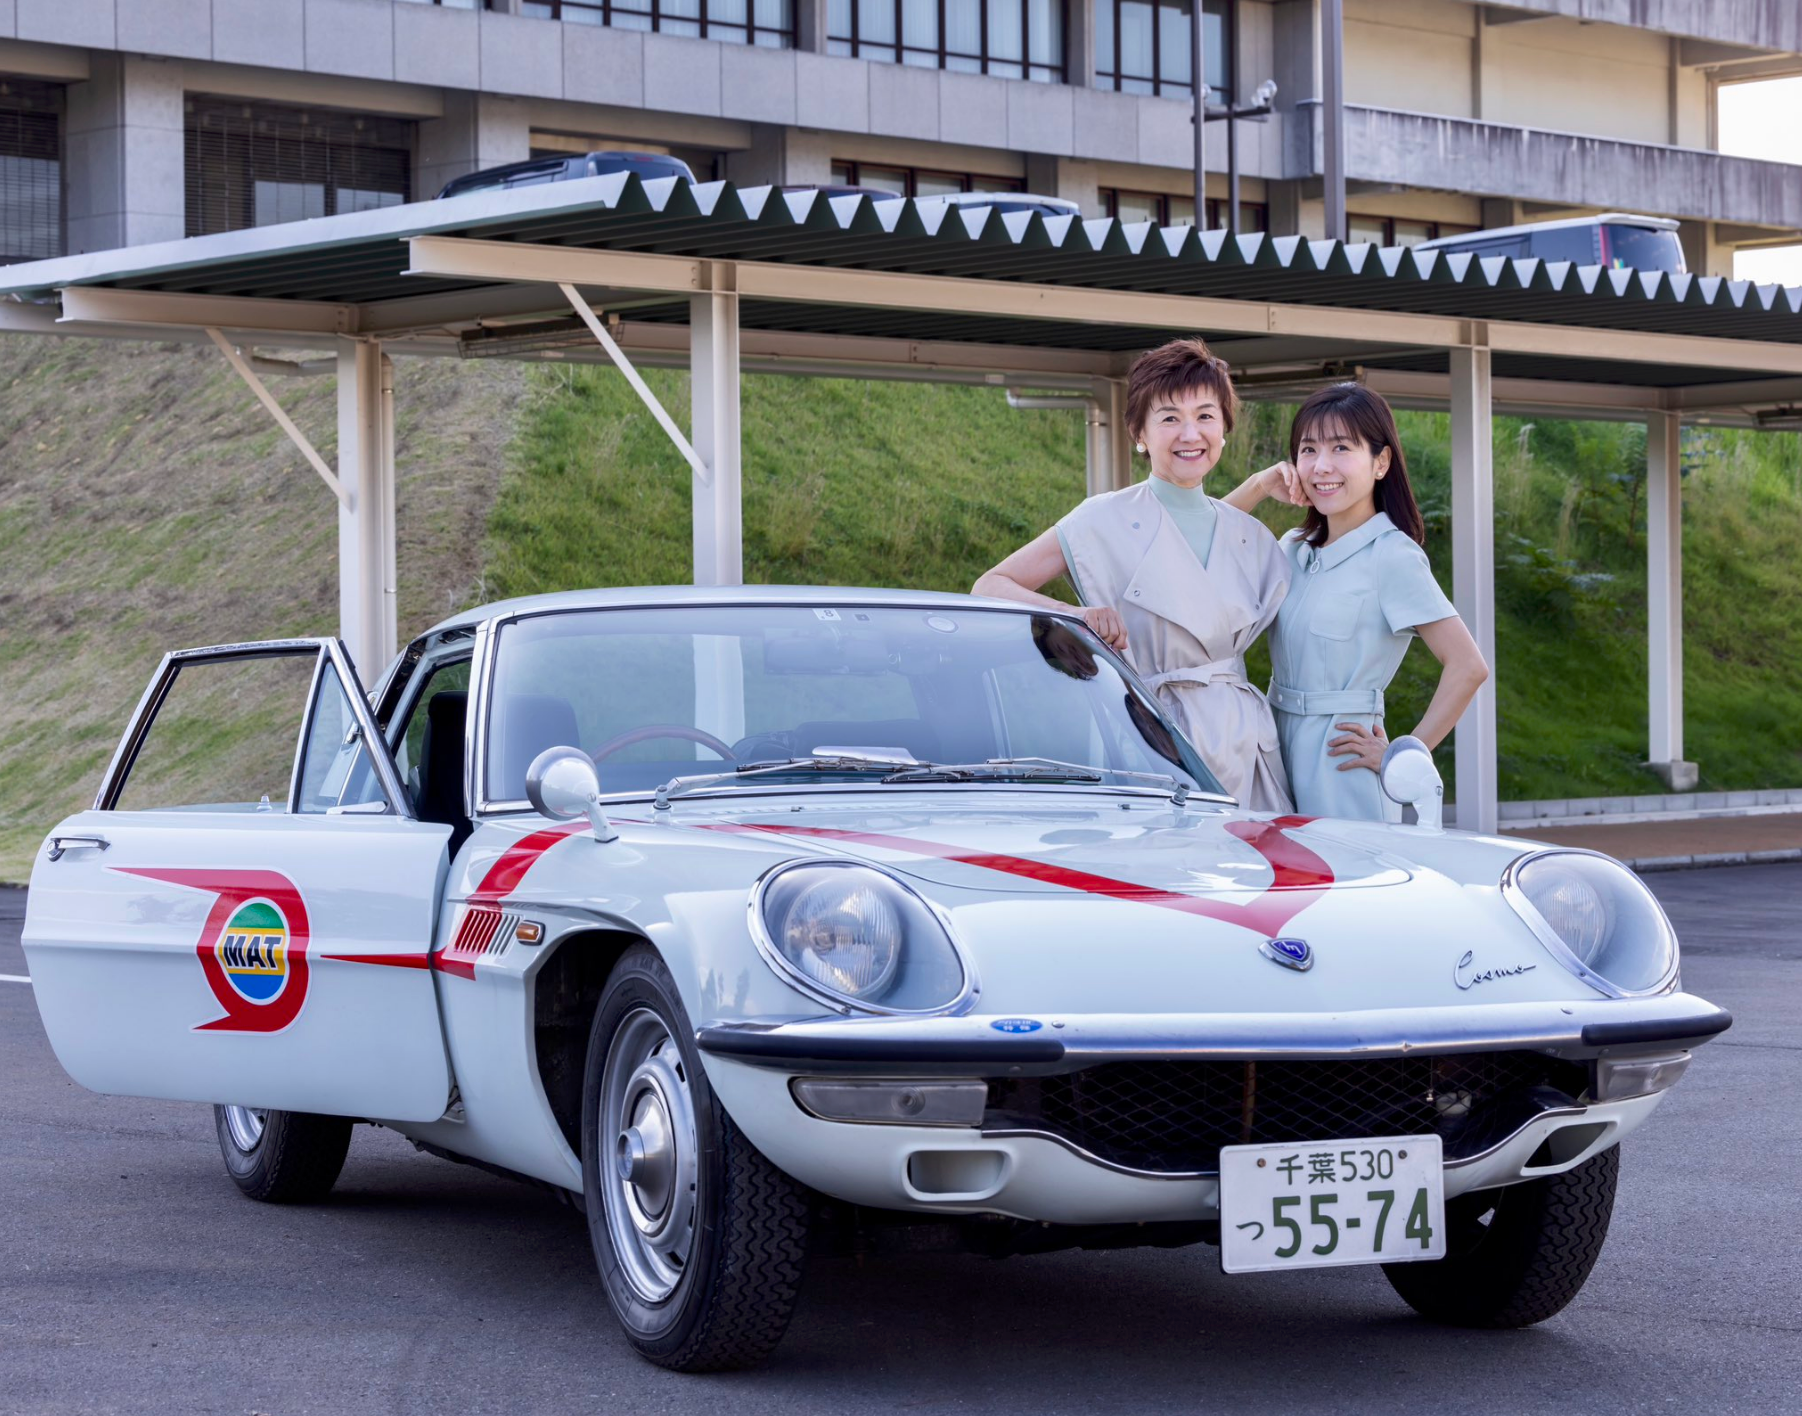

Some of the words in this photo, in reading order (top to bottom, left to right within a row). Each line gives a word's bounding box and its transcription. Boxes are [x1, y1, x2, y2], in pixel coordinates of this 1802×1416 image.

[223, 935, 283, 969] MAT
[1454, 949, 1537, 991] Cosmo
[1276, 1149, 1394, 1186] 千葉530
[1272, 1187, 1433, 1258] 55-74
